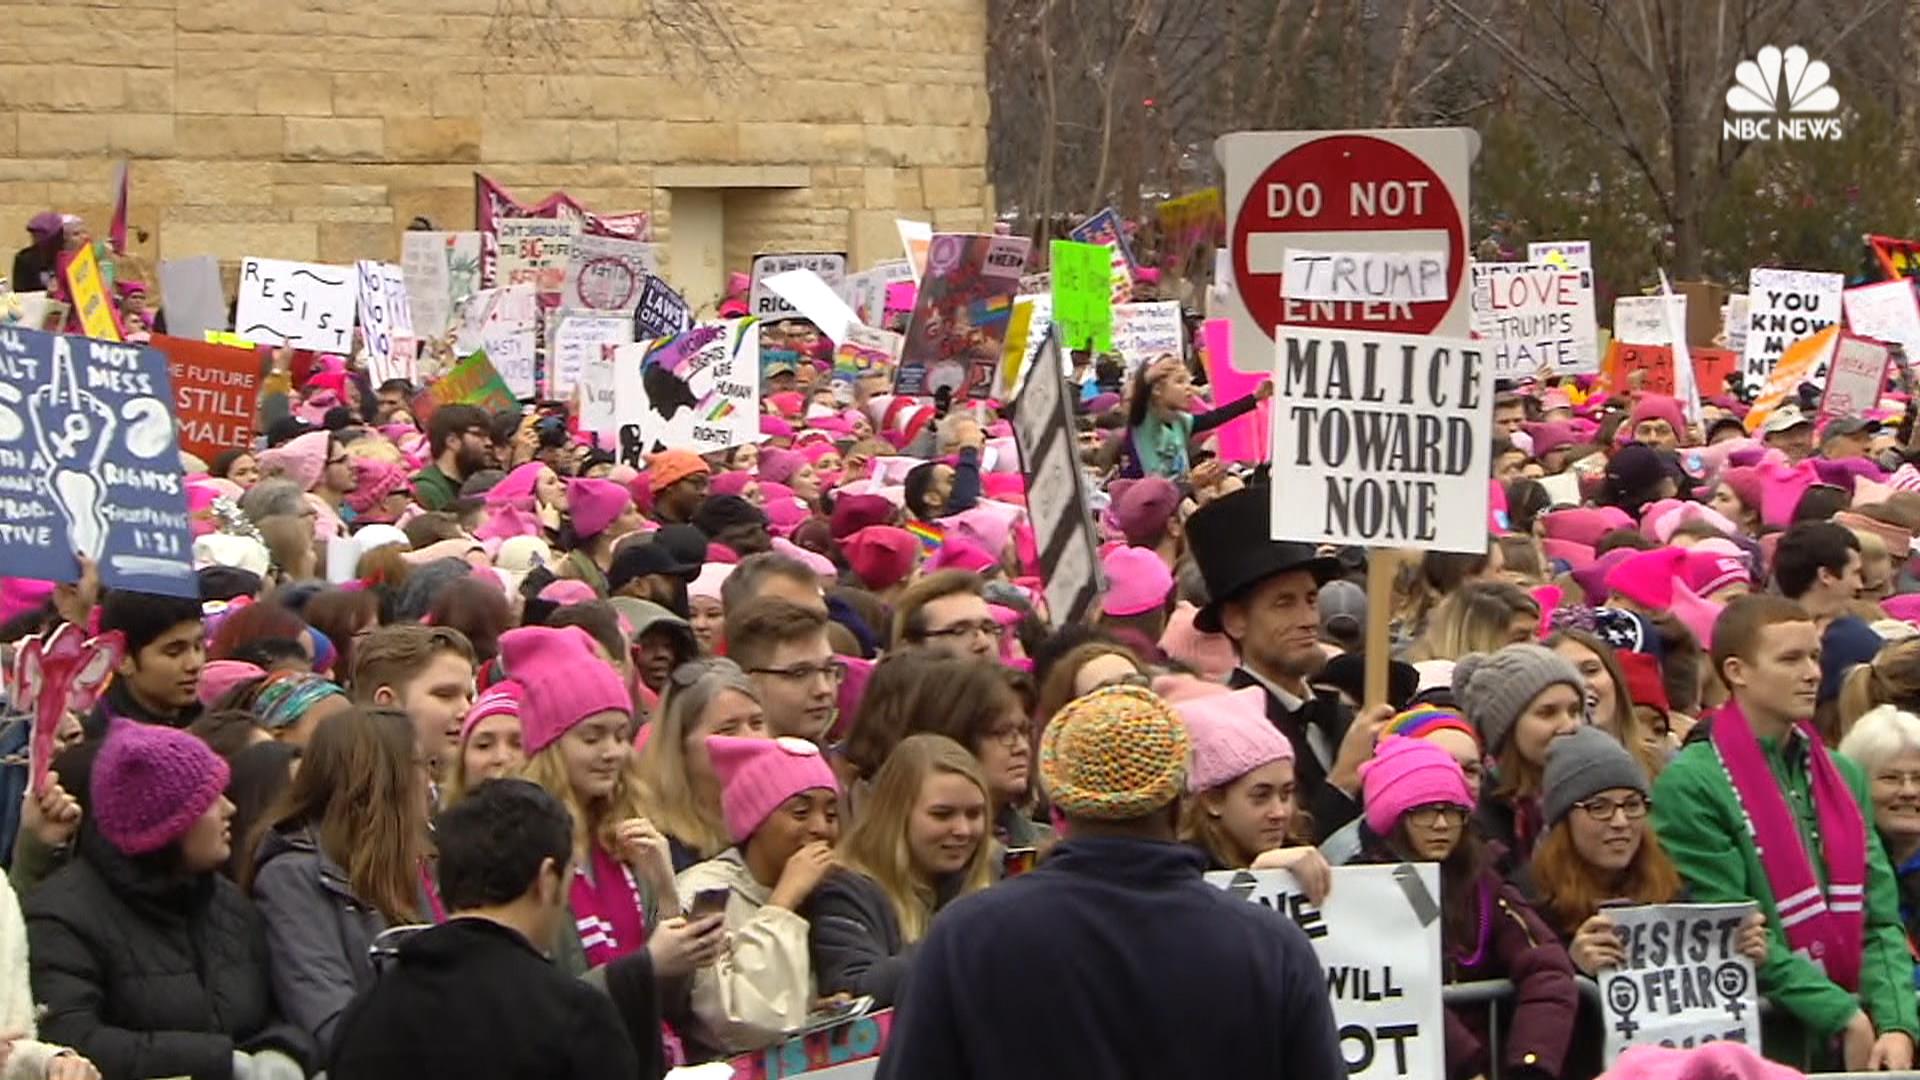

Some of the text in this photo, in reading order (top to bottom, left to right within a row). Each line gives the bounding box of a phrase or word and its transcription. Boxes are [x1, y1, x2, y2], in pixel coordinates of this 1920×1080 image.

[1266, 180, 1430, 218] DO NOT
[1293, 256, 1441, 297] TRUMP
[1490, 275, 1579, 310] LOVE
[245, 261, 345, 347] RESIST
[645, 288, 684, 328] LAWS
[1766, 290, 1820, 312] YOU
[1496, 312, 1572, 339] TRUMPS
[89, 343, 141, 370] NOT
[712, 362, 733, 379] ARE
[1495, 340, 1578, 369] HATE
[87, 366, 153, 395] MESS
[187, 364, 255, 388] FUTURE
[715, 381, 752, 399] HUMAN
[1283, 336, 1484, 410] MALICE
[177, 386, 250, 418] STILL
[1290, 405, 1474, 477] TOWARD
[103, 462, 179, 495] RIGHTS
[1324, 475, 1438, 542] NONE
[1328, 965, 1404, 1002] WILL
[1641, 966, 1717, 1016] FEAR
